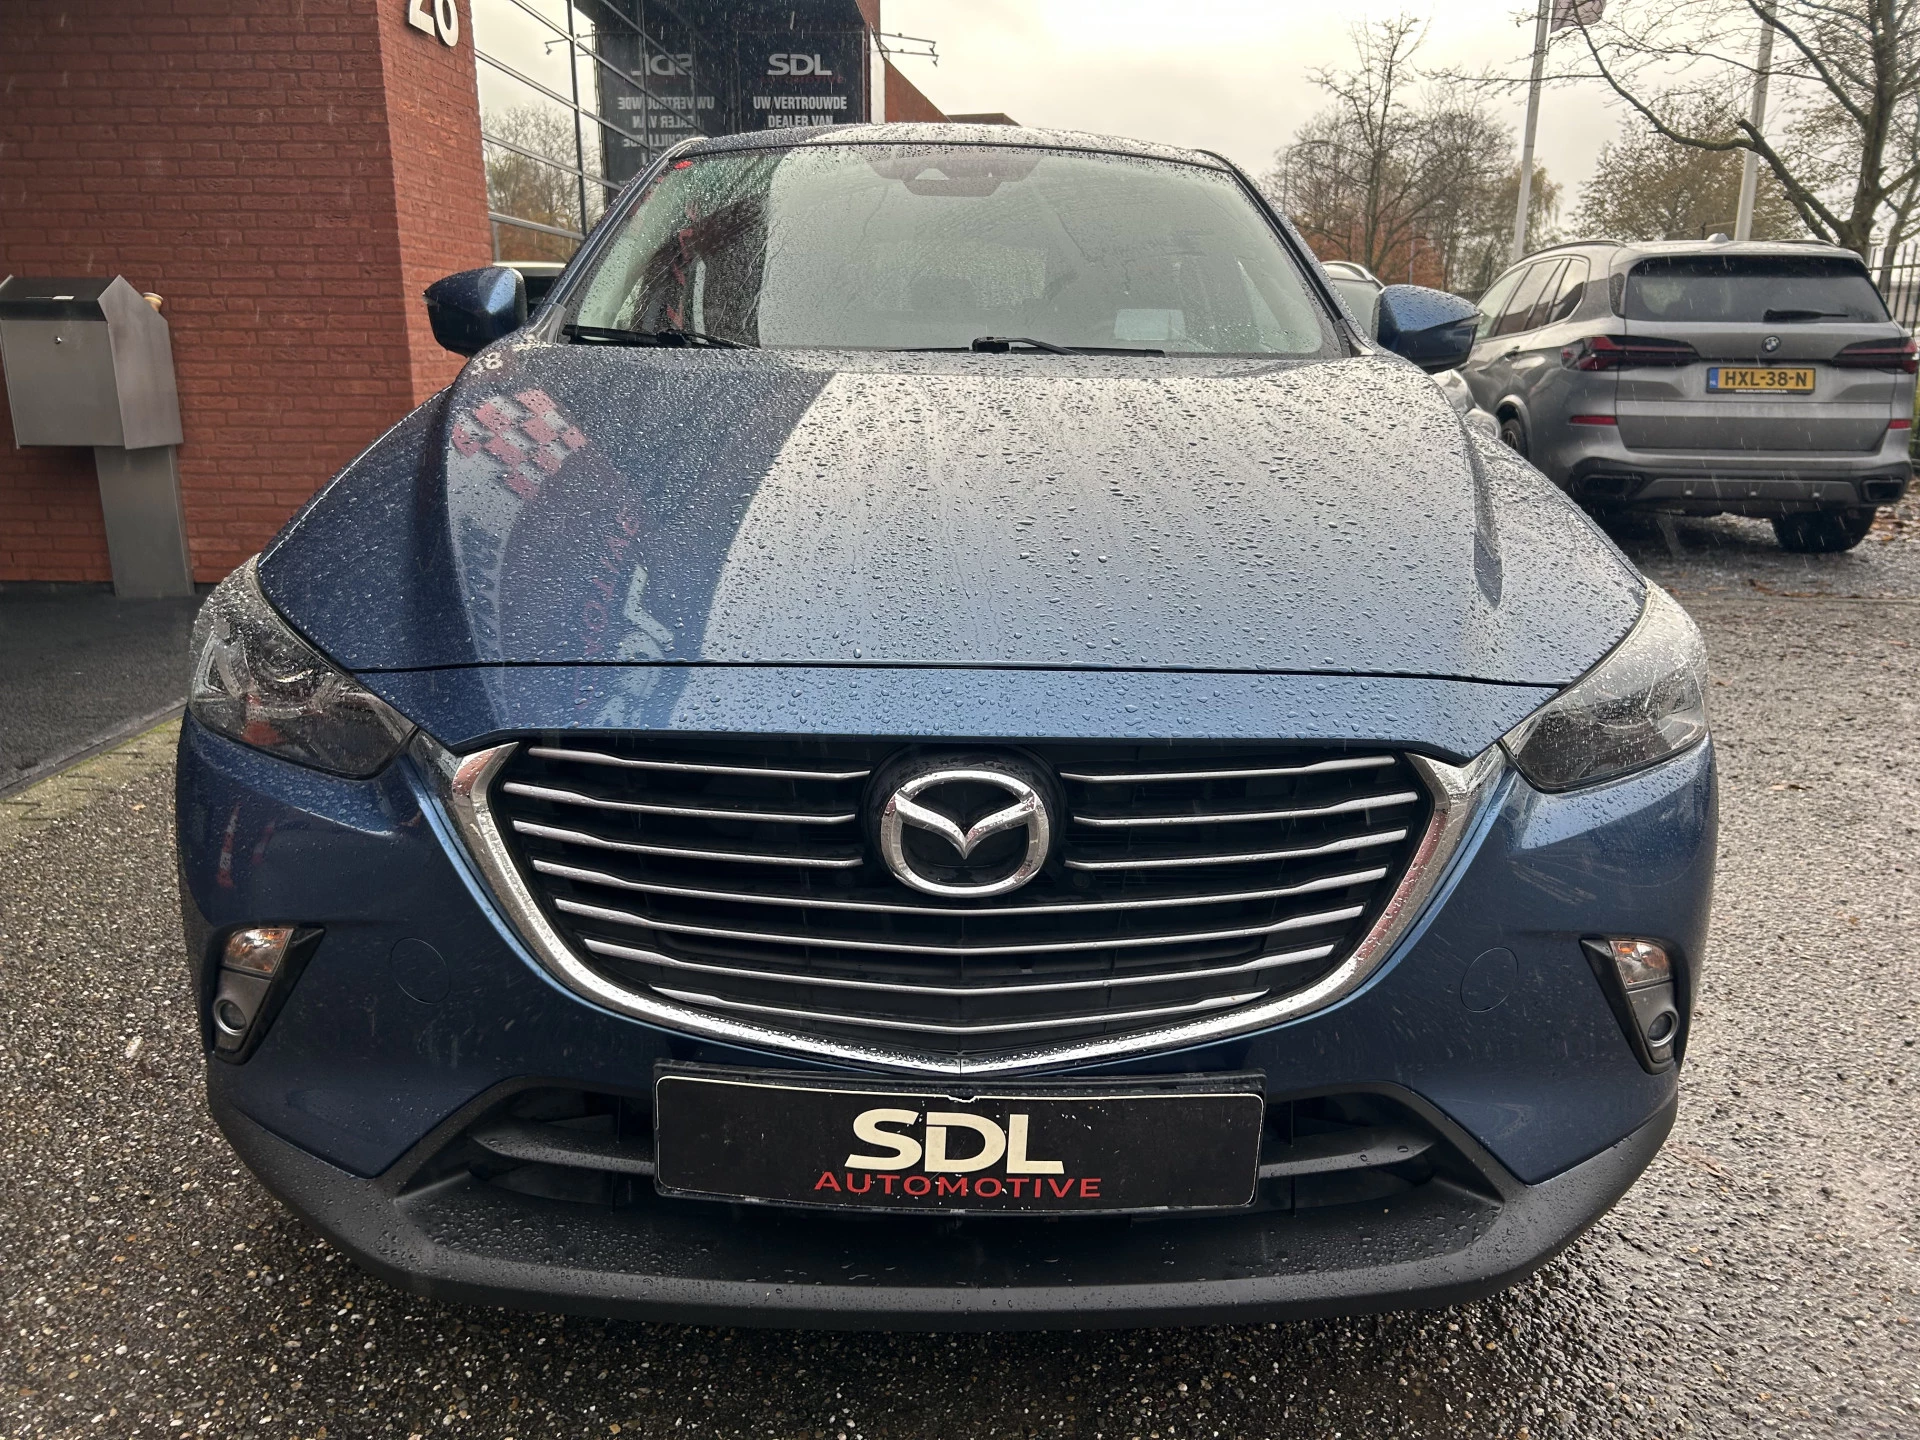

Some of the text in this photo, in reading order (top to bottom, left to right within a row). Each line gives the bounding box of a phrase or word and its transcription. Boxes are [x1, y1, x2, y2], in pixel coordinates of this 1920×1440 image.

[767, 54, 833, 76] SDL
[753, 96, 847, 110] UW VERTROUWDE
[768, 115, 833, 128] DEALER VAN
[1725, 371, 1807, 387] HXL-38-N
[844, 1108, 1064, 1174] SDL
[814, 1171, 1101, 1198] AUTOMOTIVE
